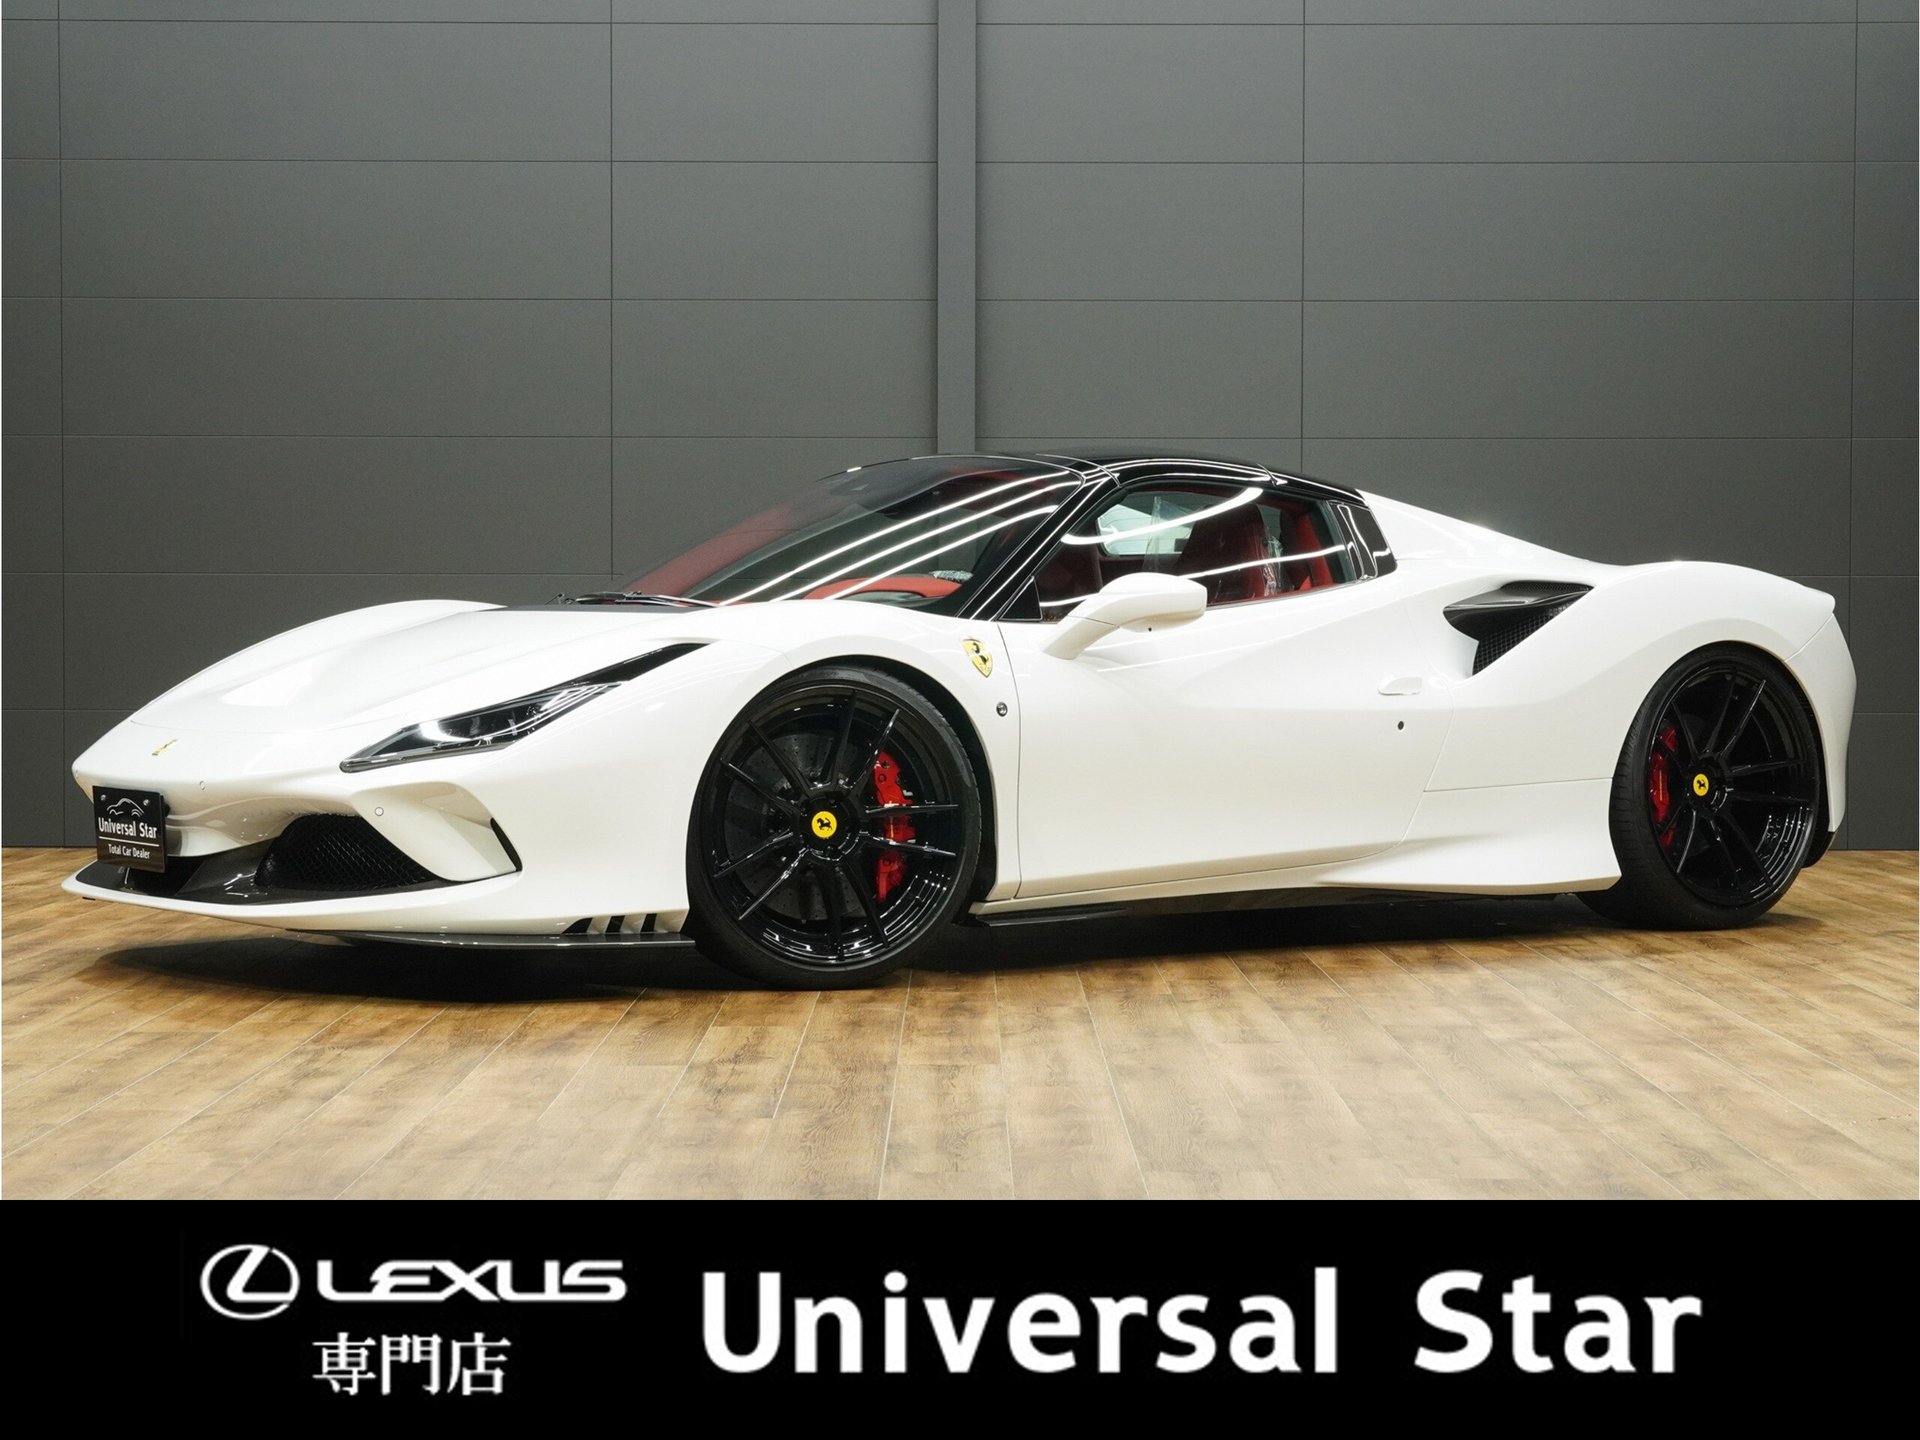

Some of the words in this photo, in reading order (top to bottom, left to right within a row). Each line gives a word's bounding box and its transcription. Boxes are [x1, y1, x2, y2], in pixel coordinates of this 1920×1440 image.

[98, 817, 137, 836] Universal
[139, 822, 157, 838] Star
[108, 843, 121, 854] Total
[122, 845, 132, 856] Car
[132, 847, 150, 859] Dealer
